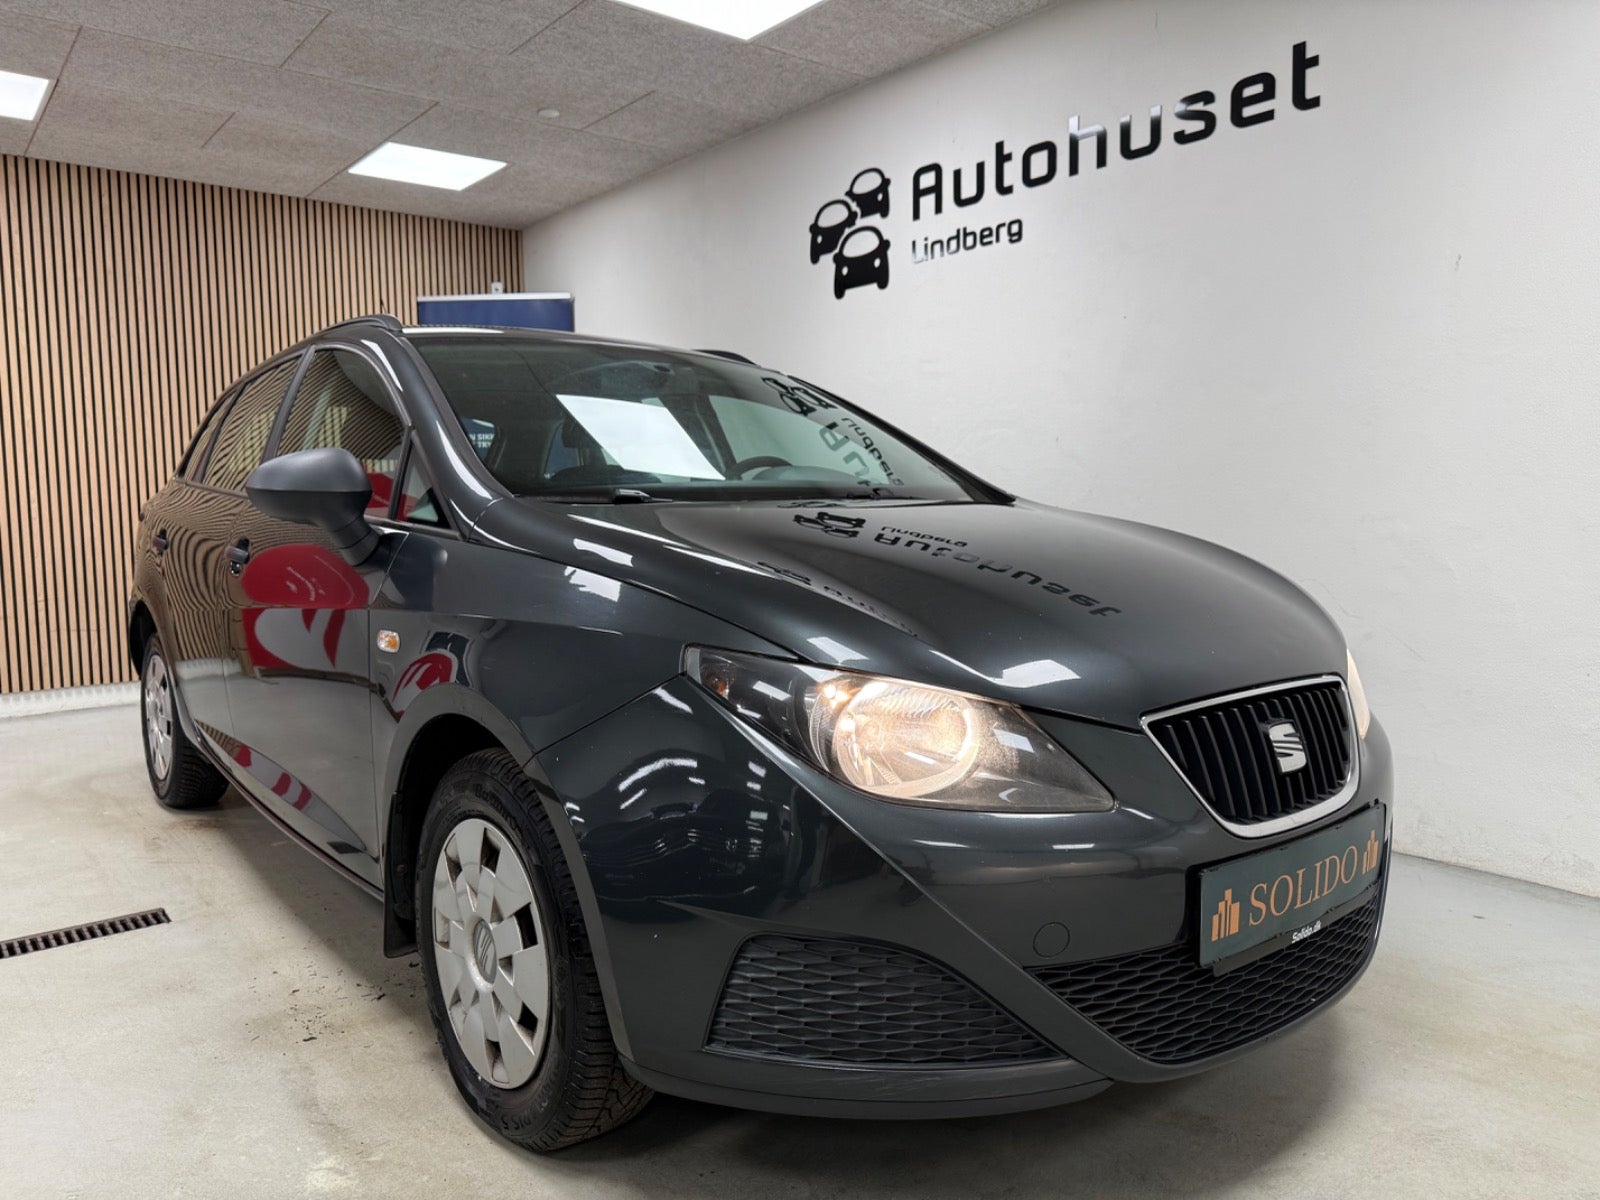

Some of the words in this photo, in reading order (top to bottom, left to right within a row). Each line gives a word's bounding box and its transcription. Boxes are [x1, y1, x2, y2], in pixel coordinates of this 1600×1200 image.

[912, 40, 1321, 221] Autohuset
[911, 219, 1024, 265] Lindberg
[1249, 845, 1358, 927] SOLIDO
